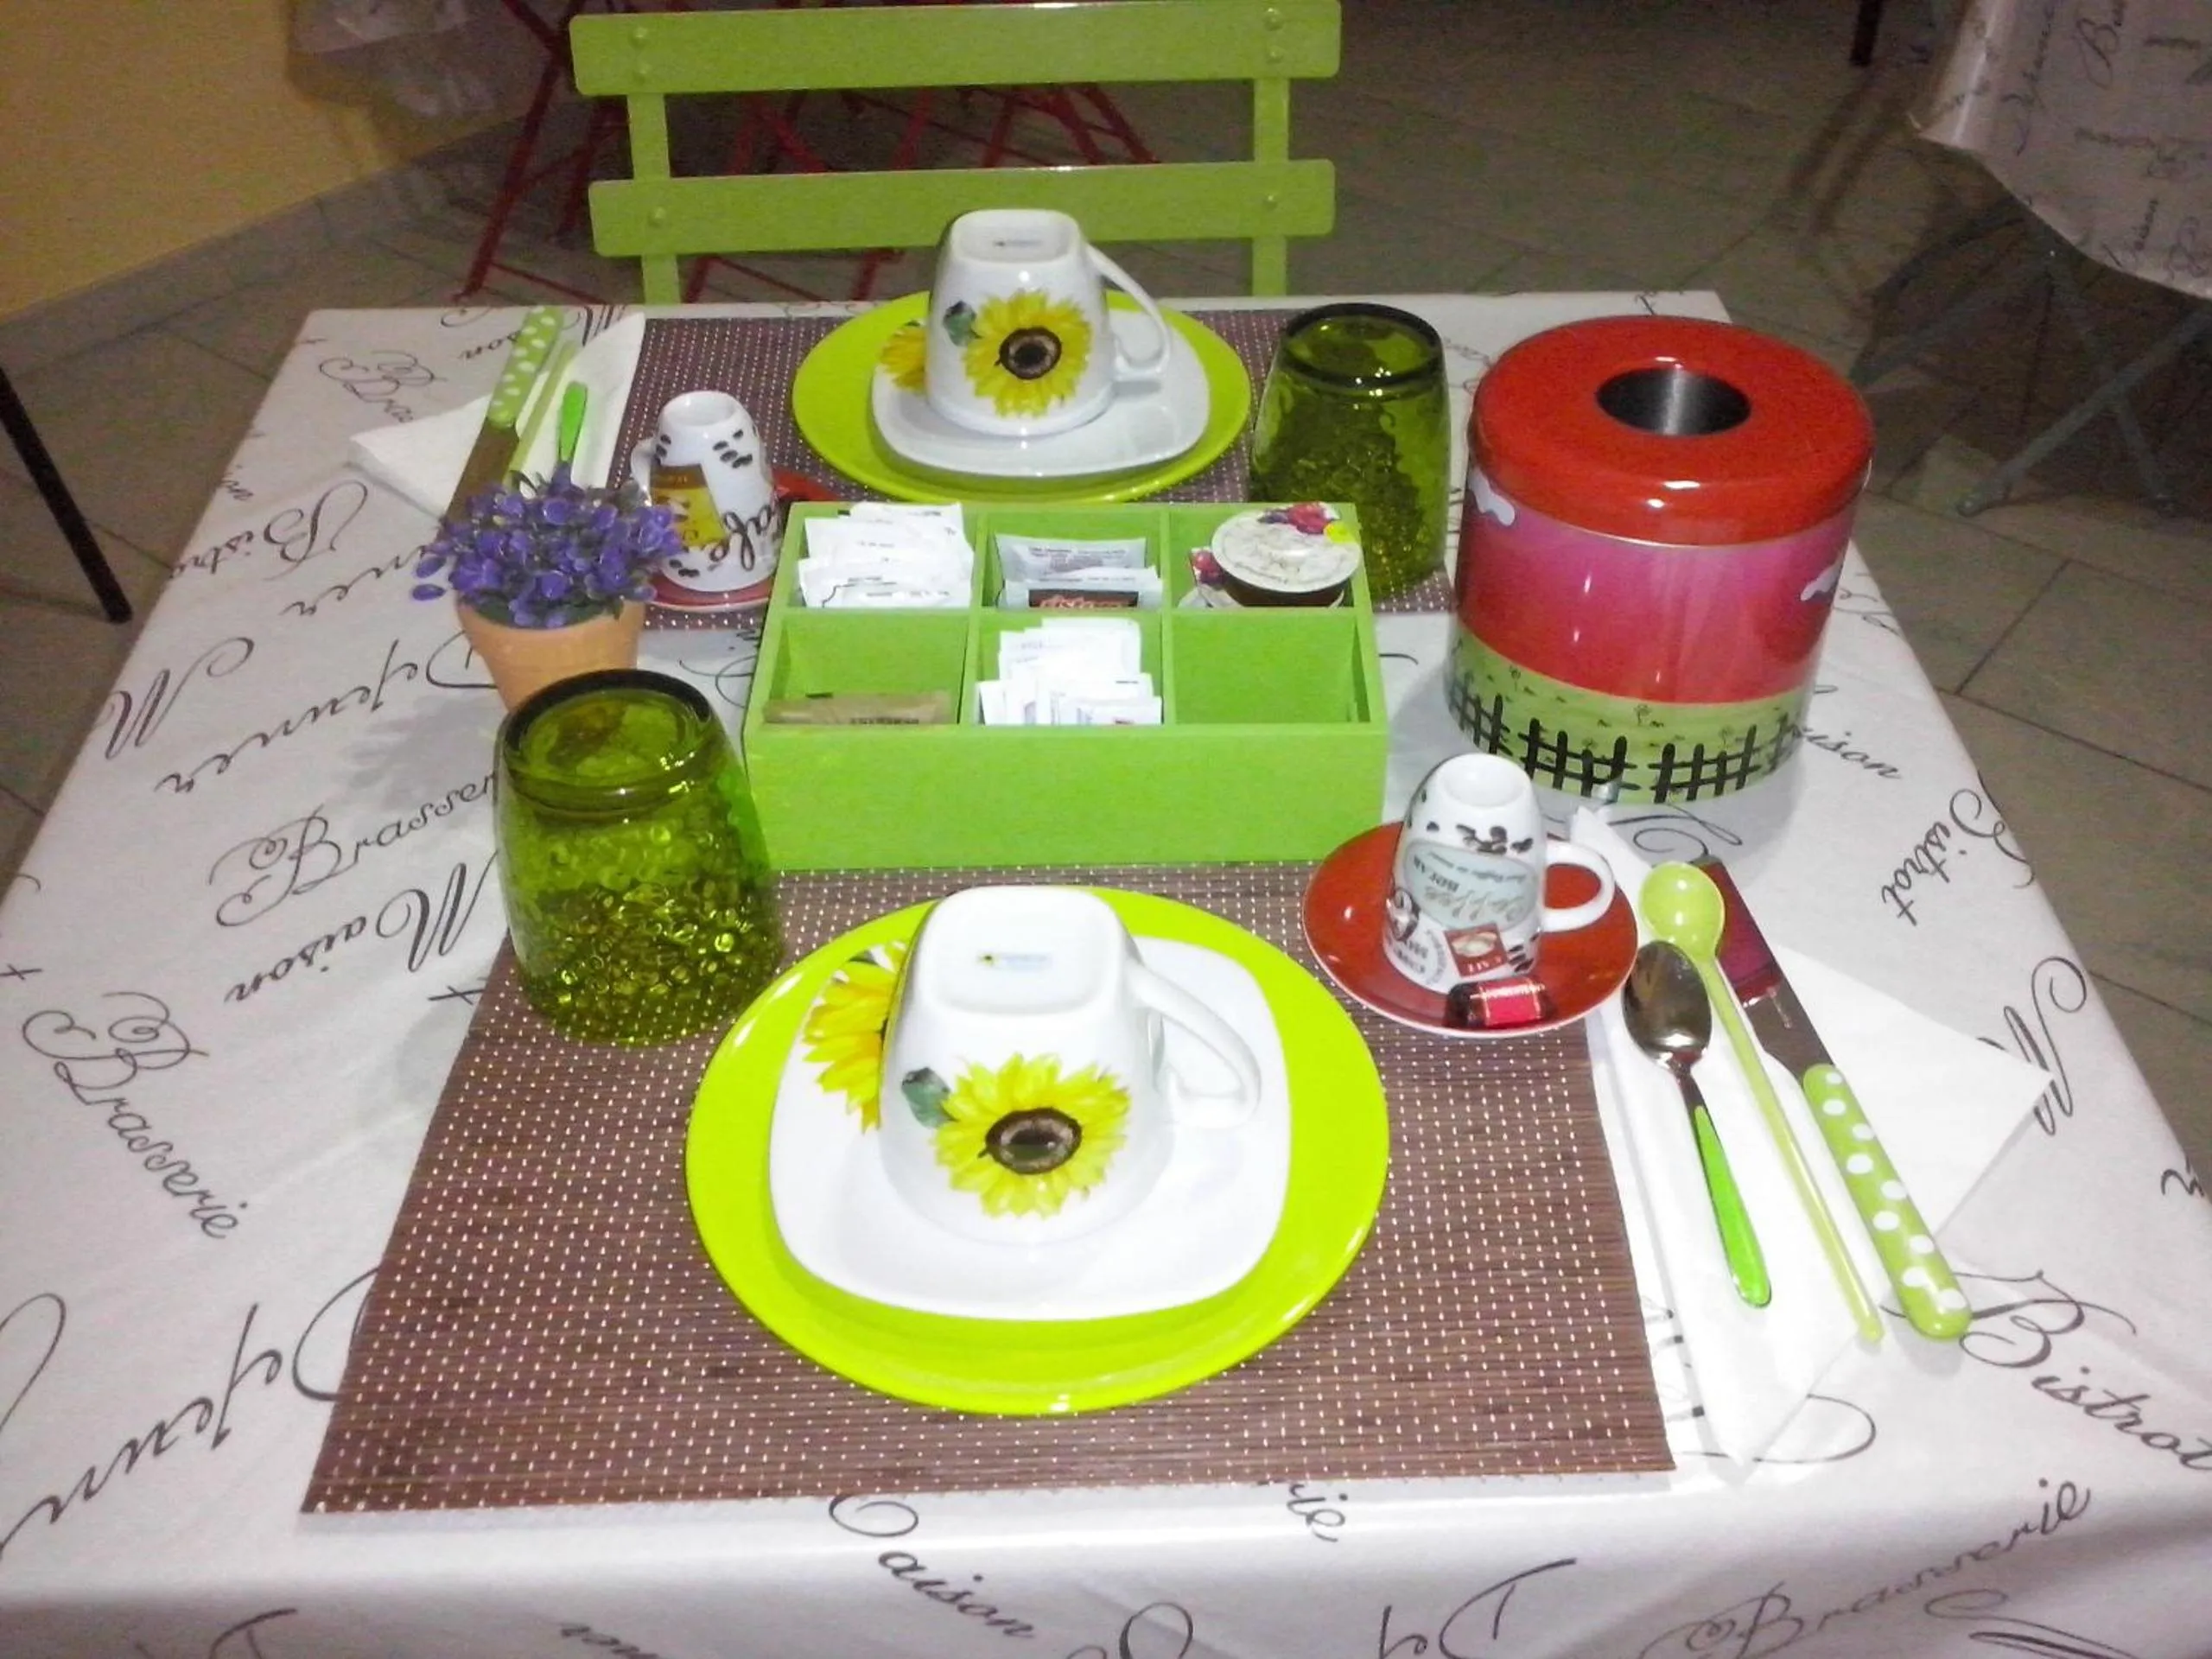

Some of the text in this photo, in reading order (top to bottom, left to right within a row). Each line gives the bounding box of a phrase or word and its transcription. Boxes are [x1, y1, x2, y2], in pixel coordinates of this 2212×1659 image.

[170, 480, 368, 581] Bistro
[209, 772, 495, 927] Brasser
[224, 850, 499, 1003] Maison
[22, 991, 249, 1239] Brasserie
[1641, 1478, 2091, 1659] Brasserie
